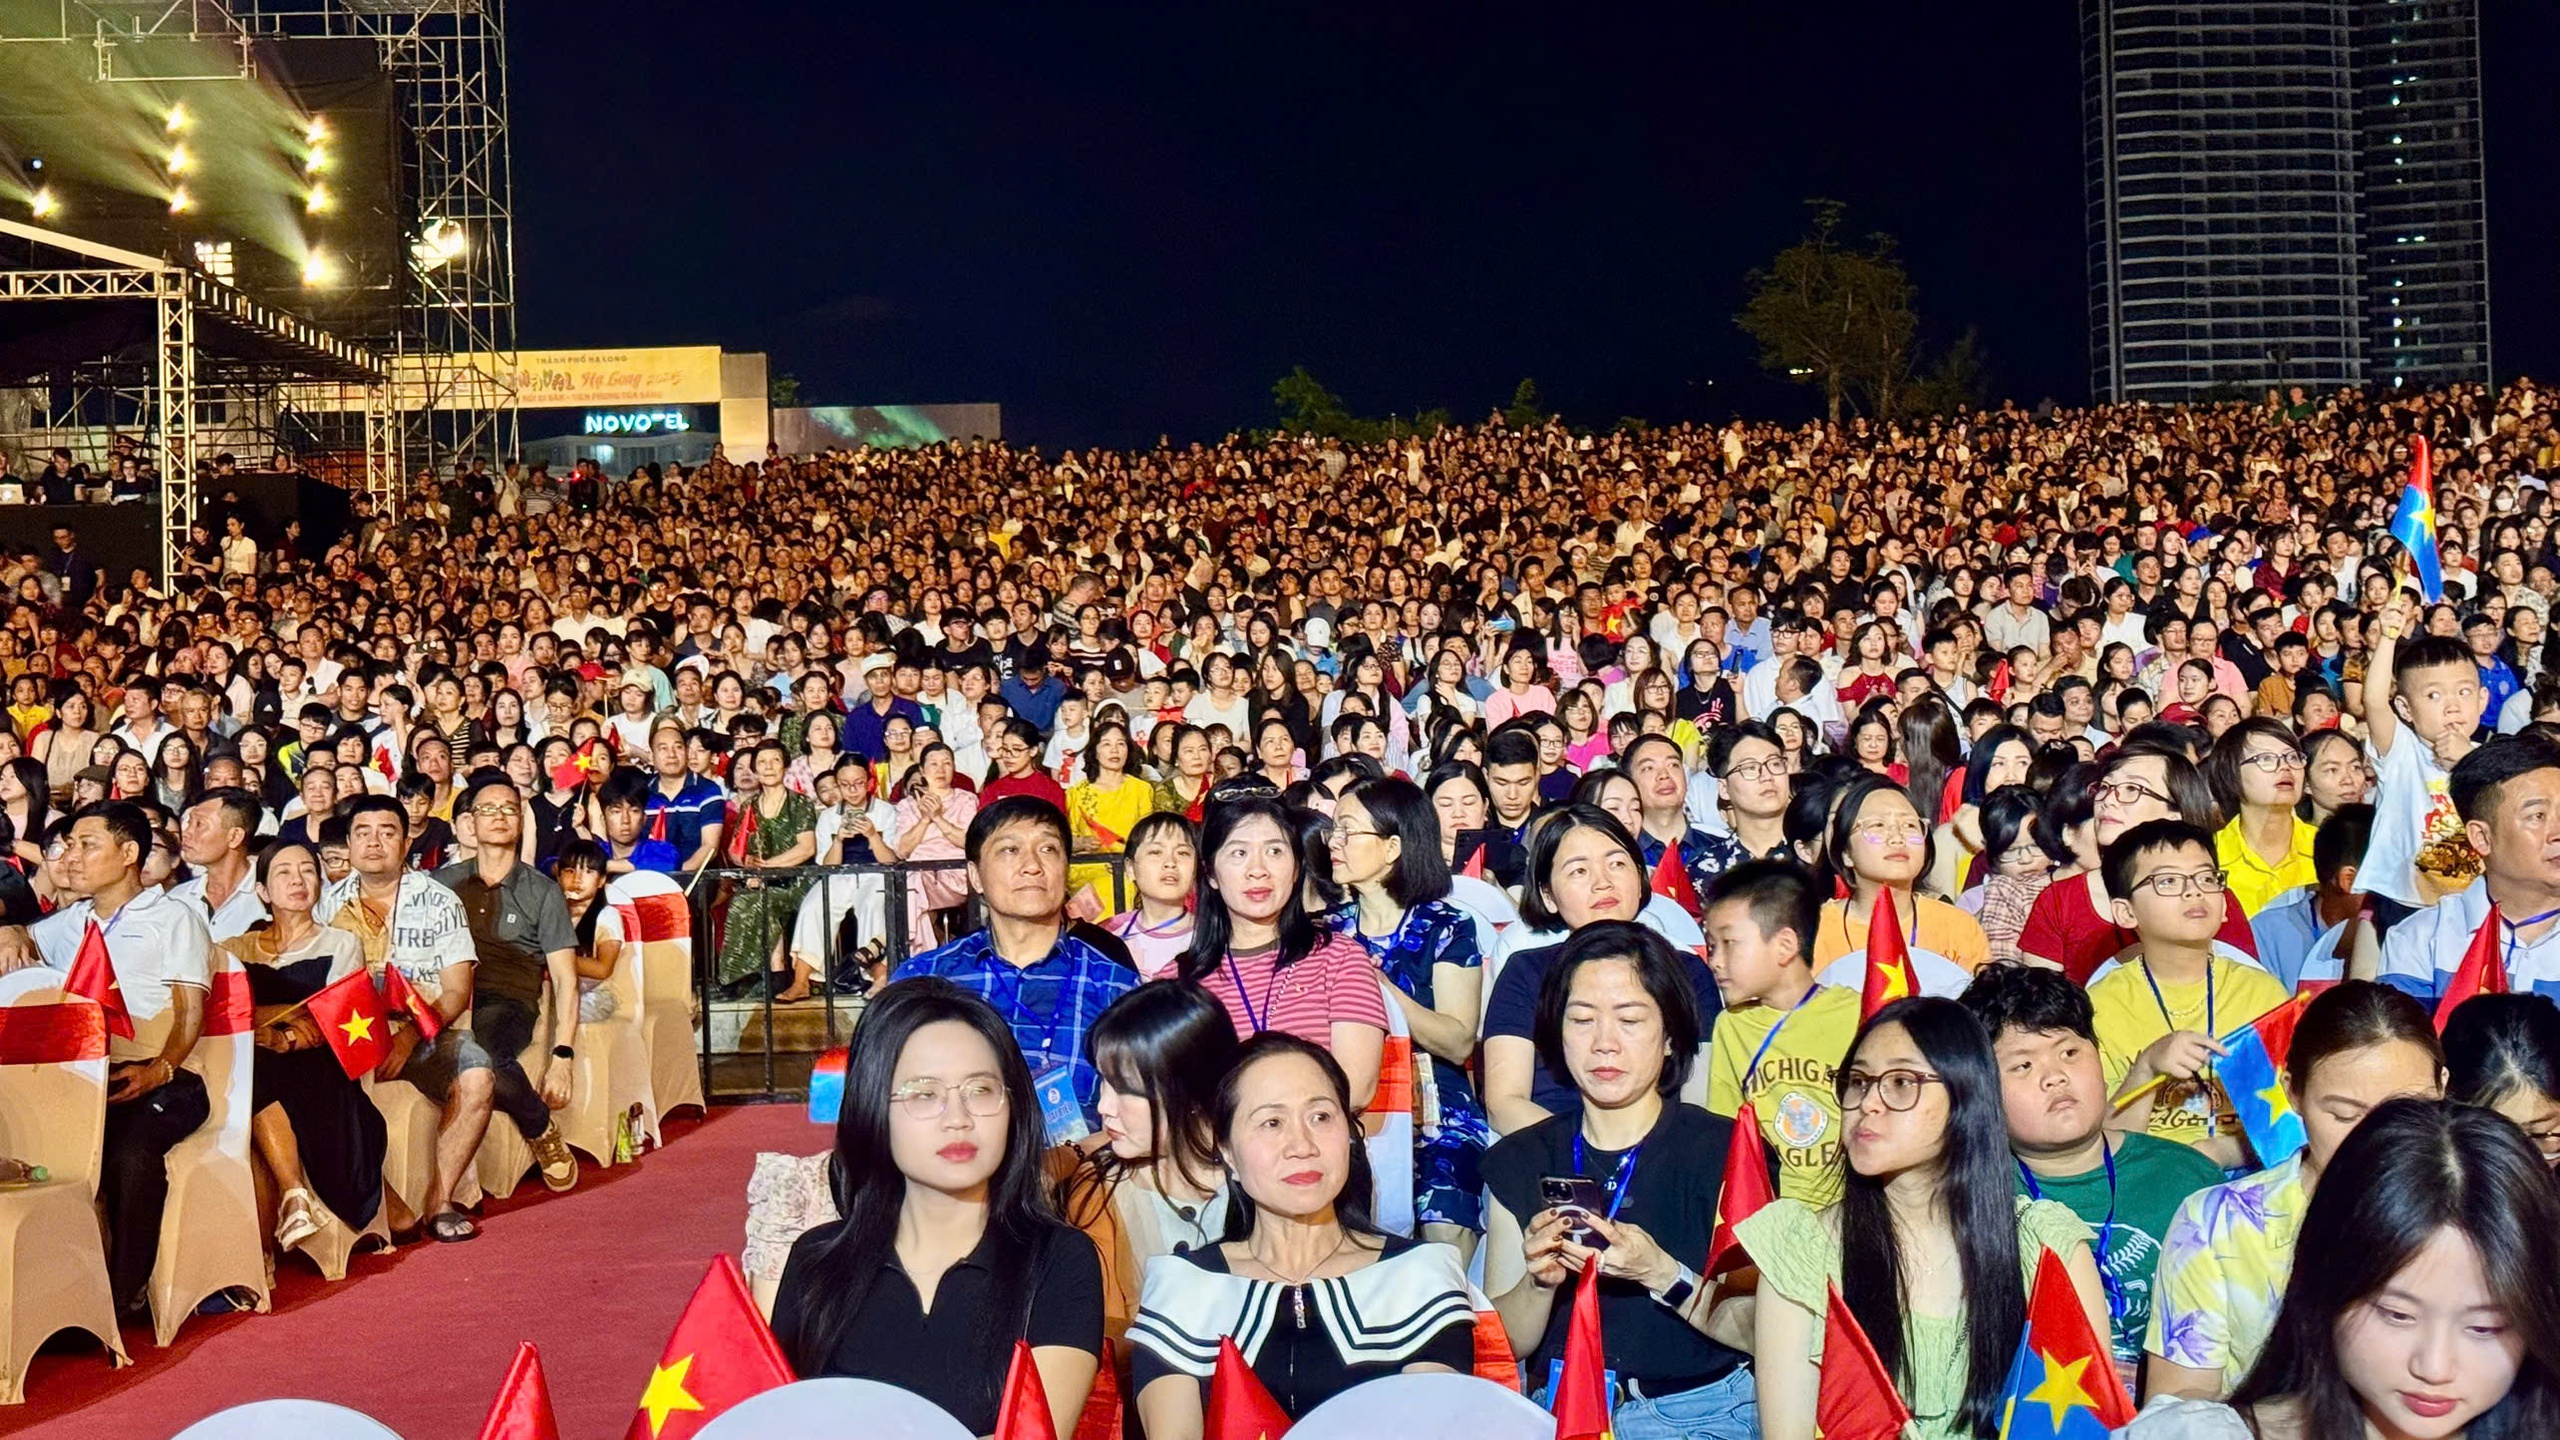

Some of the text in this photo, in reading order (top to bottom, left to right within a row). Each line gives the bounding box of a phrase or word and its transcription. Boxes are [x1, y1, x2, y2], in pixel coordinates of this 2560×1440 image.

[602, 355, 629, 363] LONG
[606, 371, 642, 388] Long
[1750, 1057, 1834, 1094] ICHIGA
